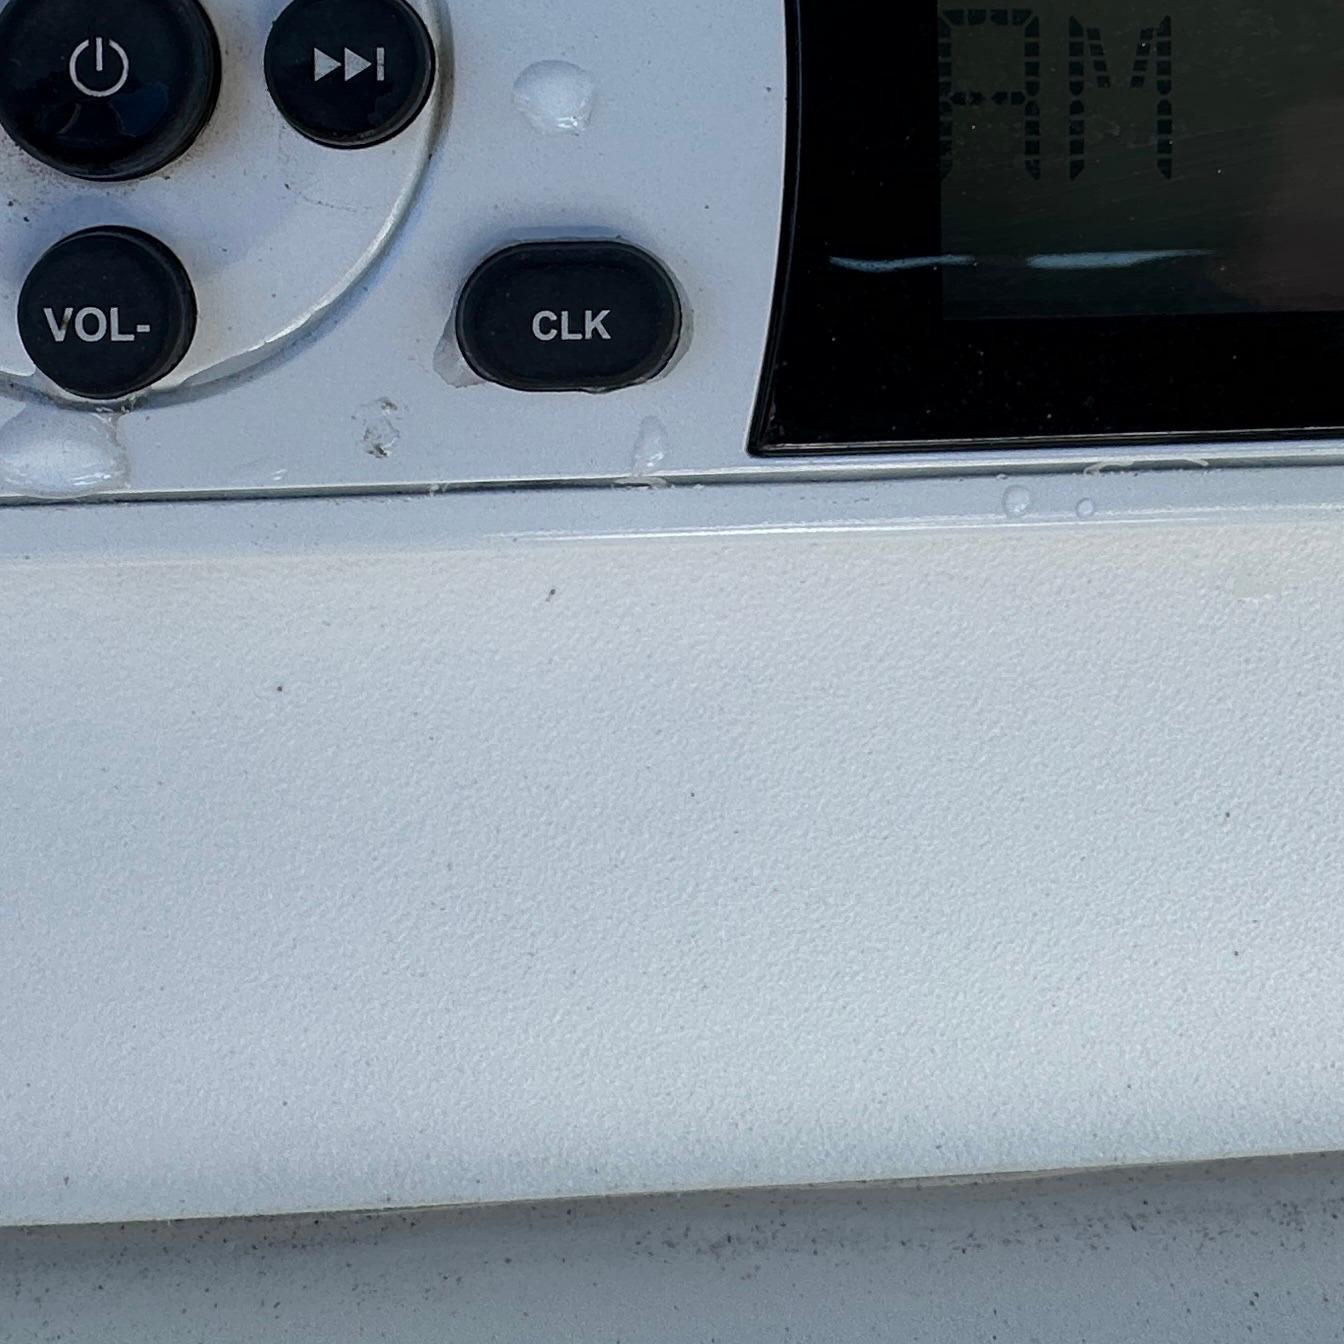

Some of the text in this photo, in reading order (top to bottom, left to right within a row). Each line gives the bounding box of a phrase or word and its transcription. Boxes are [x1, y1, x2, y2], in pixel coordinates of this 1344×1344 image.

[937, 7, 1173, 182] AM
[43, 307, 151, 343] VOL-
[531, 309, 611, 341] CLK
